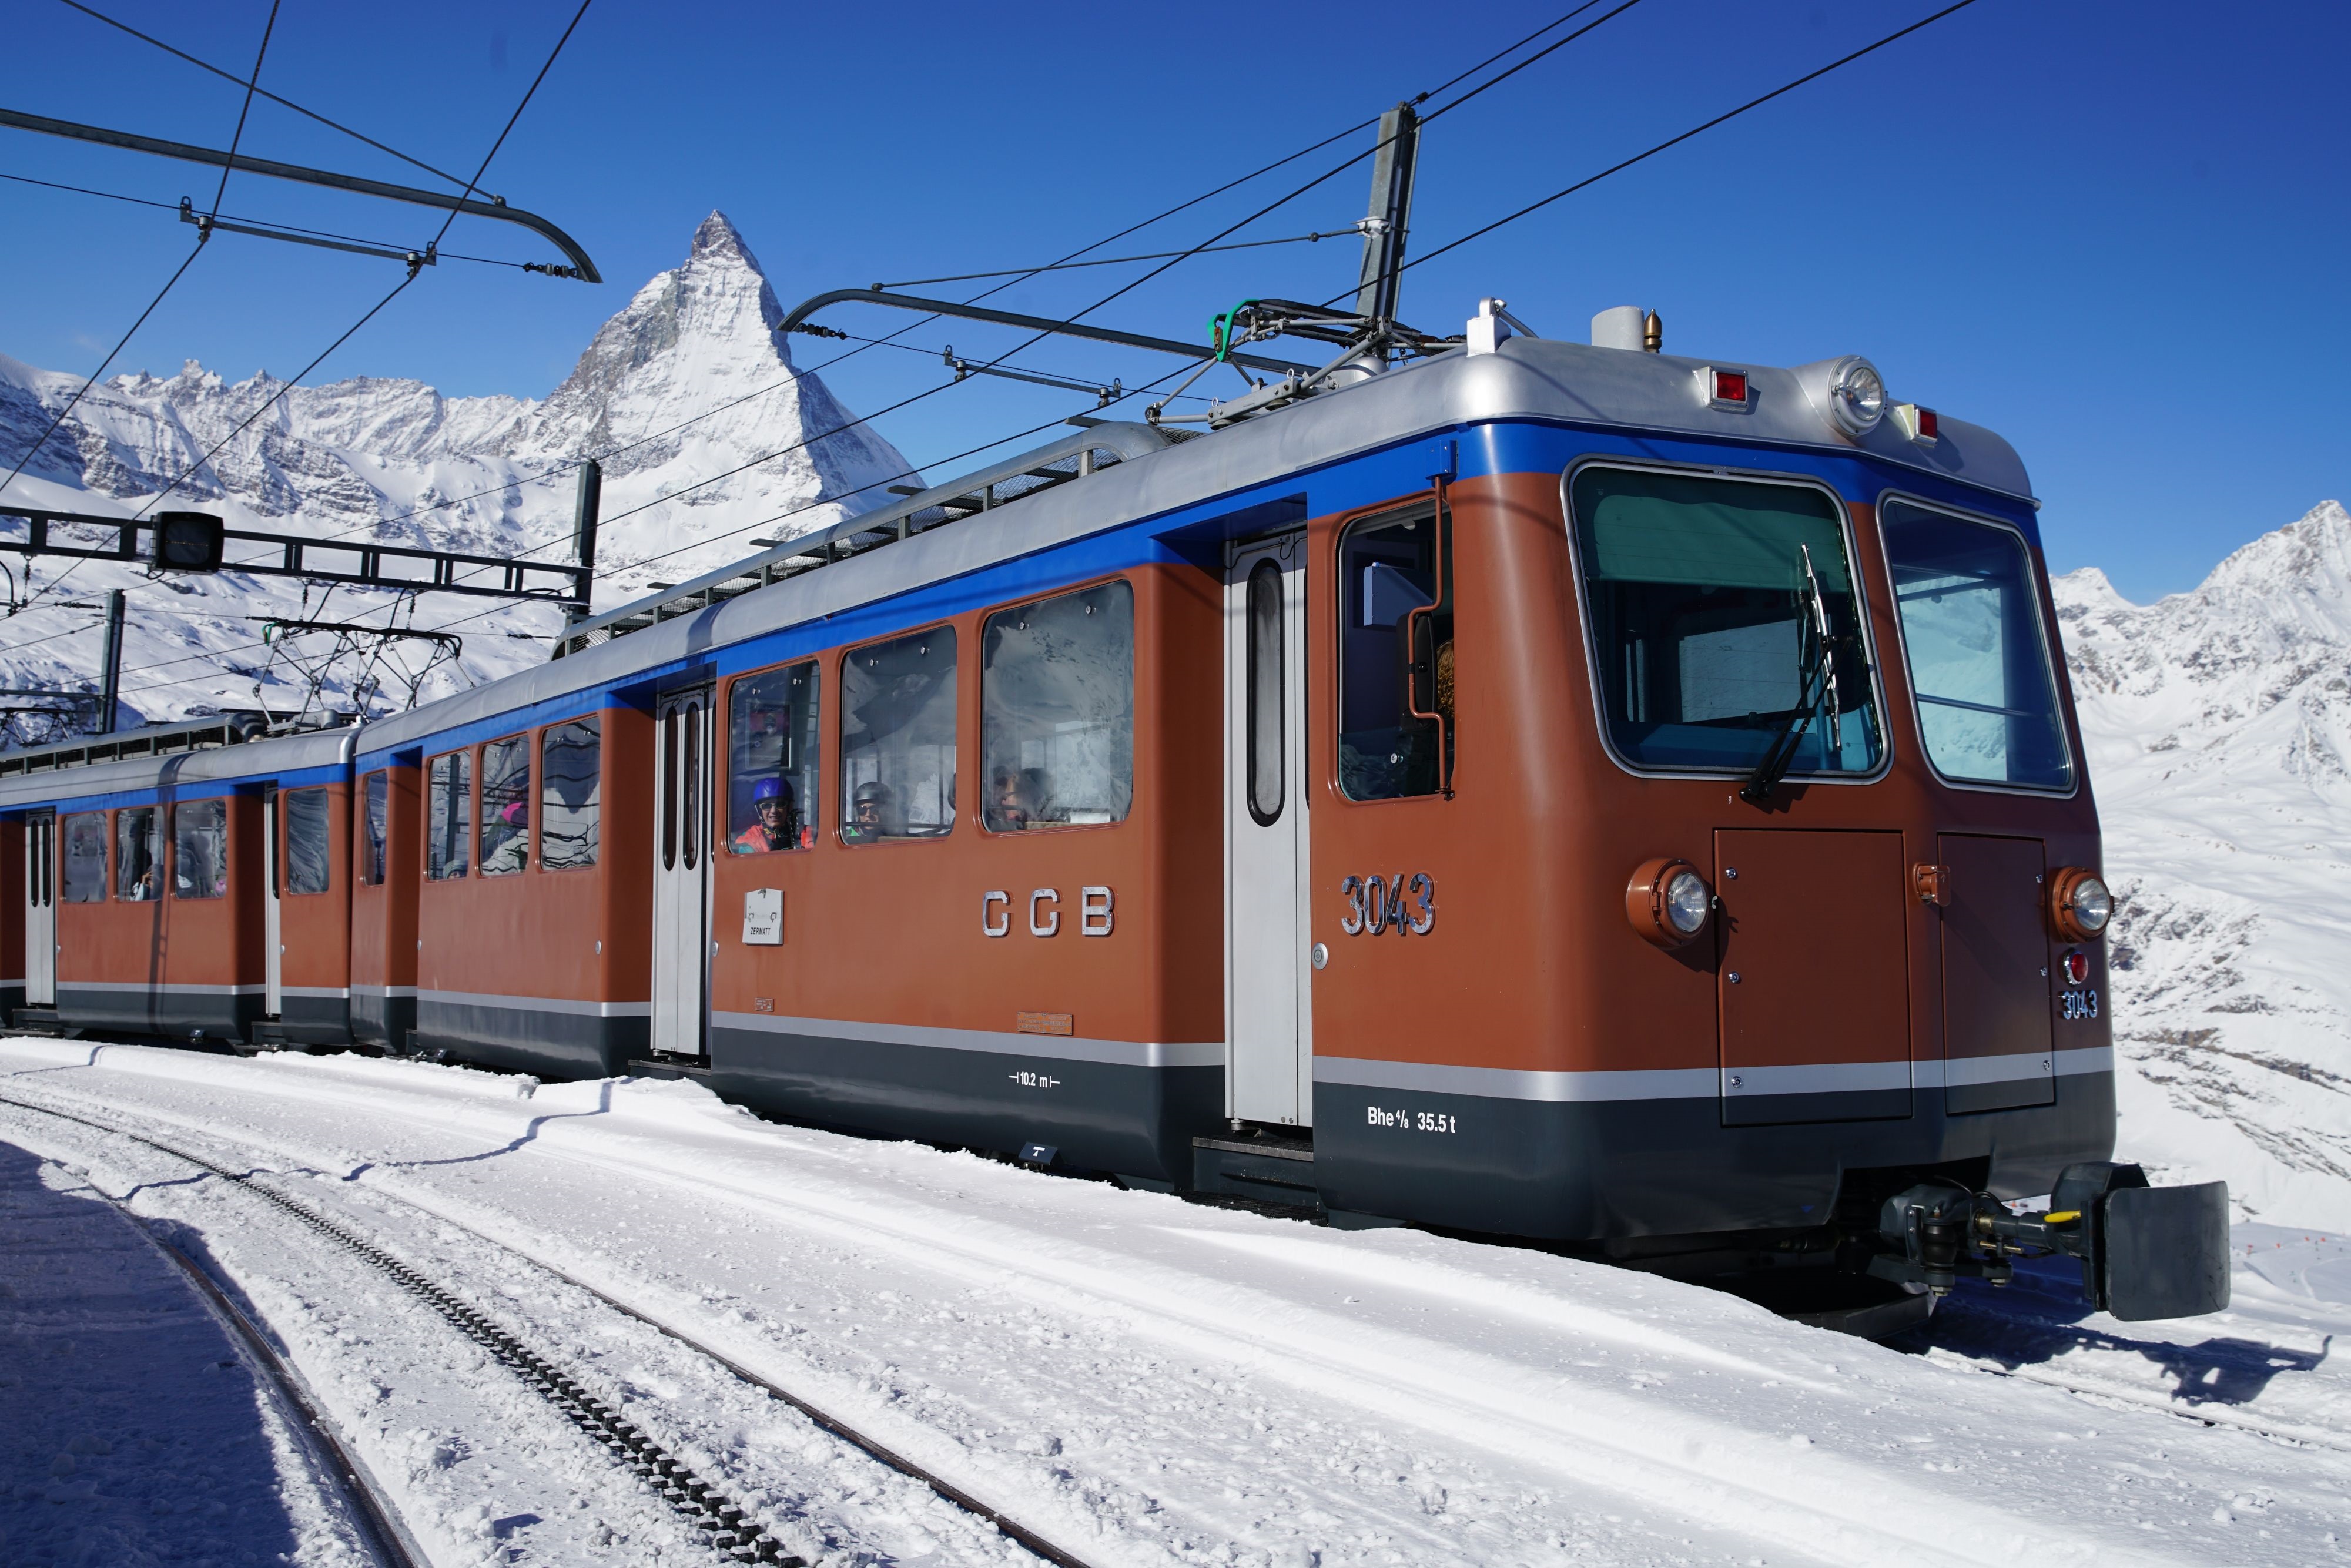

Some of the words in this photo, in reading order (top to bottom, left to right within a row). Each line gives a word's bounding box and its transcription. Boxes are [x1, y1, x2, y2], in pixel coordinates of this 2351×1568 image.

[1341, 873, 1435, 935] 3043
[2062, 990, 2097, 1020] 3043
[1020, 1071, 1036, 1086] 10.2
[1040, 1076, 1047, 1087] m
[1417, 1113, 1446, 1132] 35.5
[1450, 1115, 1455, 1133] t
